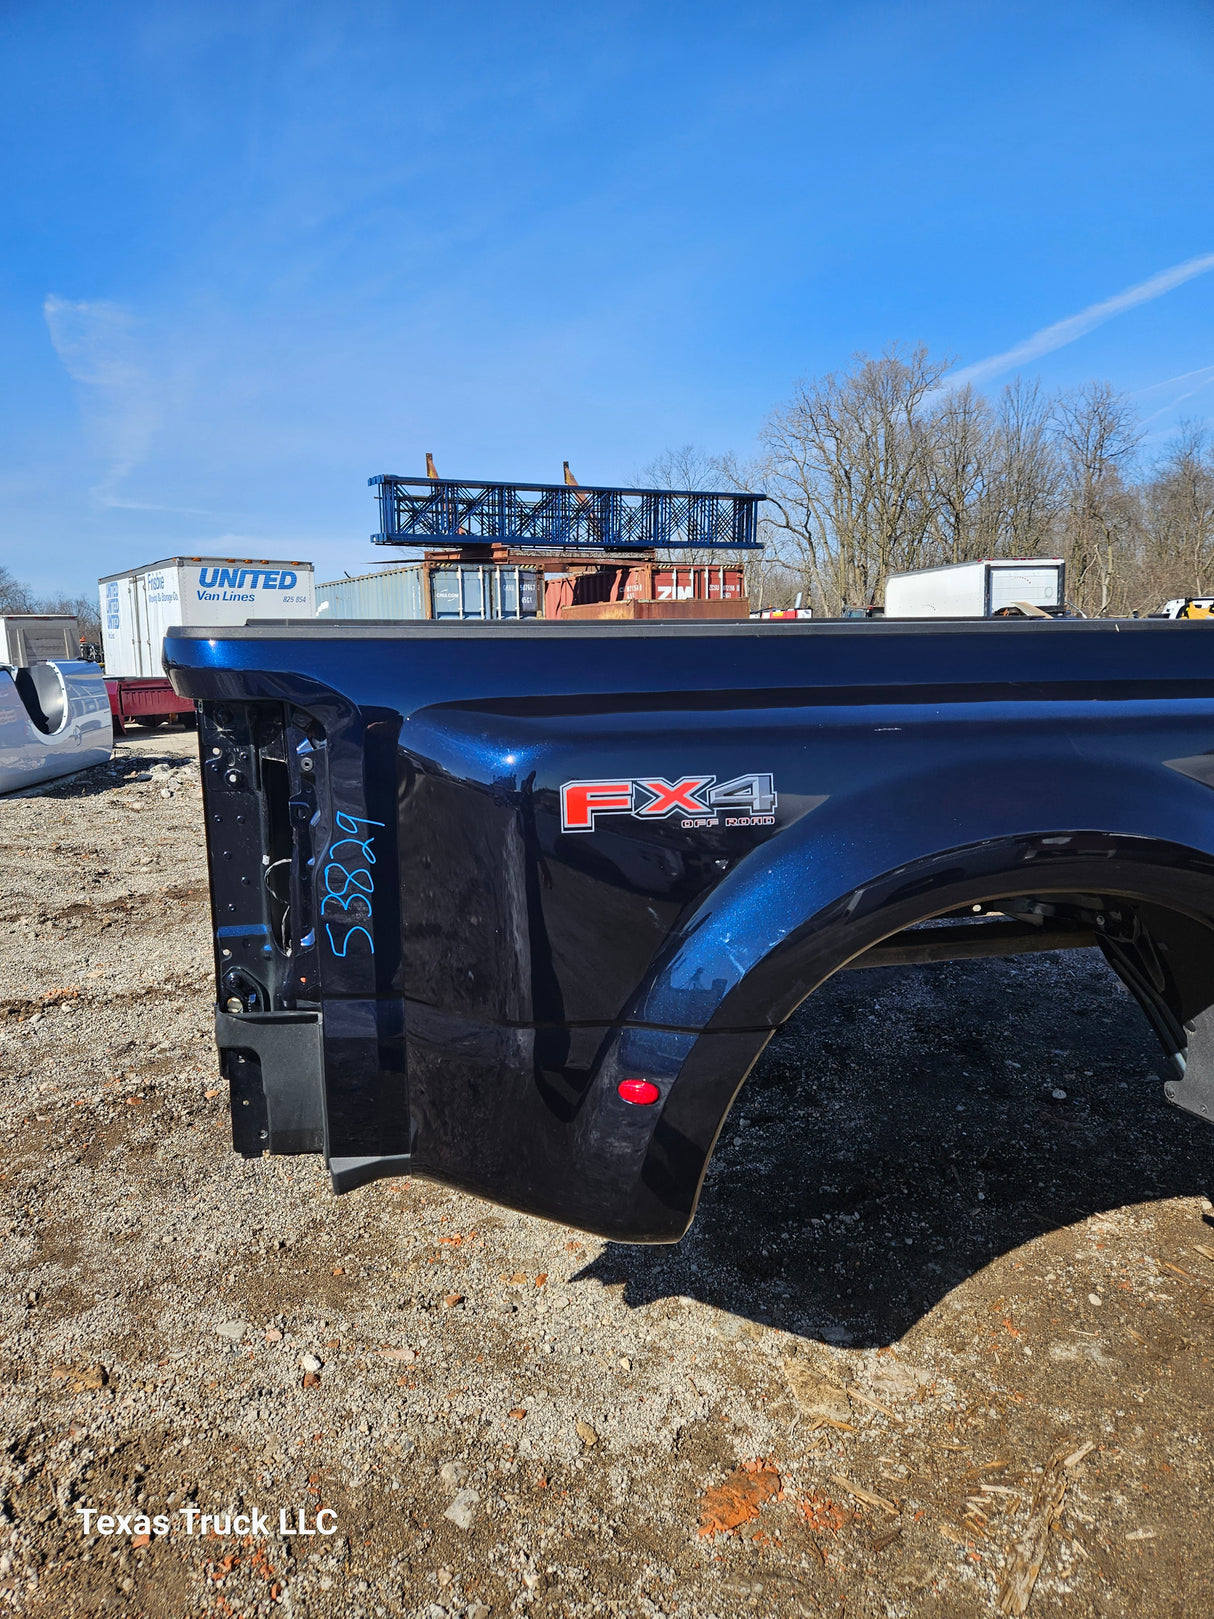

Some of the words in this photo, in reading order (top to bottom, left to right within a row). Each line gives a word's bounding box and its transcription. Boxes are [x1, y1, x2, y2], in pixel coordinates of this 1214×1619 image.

[199, 567, 298, 590] UNITED
[196, 590, 220, 601] Van
[222, 590, 256, 602] Lines
[657, 586, 693, 600] ZIM
[559, 772, 778, 834] FX4
[681, 818, 719, 829] OFF
[725, 816, 776, 827] ROAD
[320, 810, 386, 957] 53829
